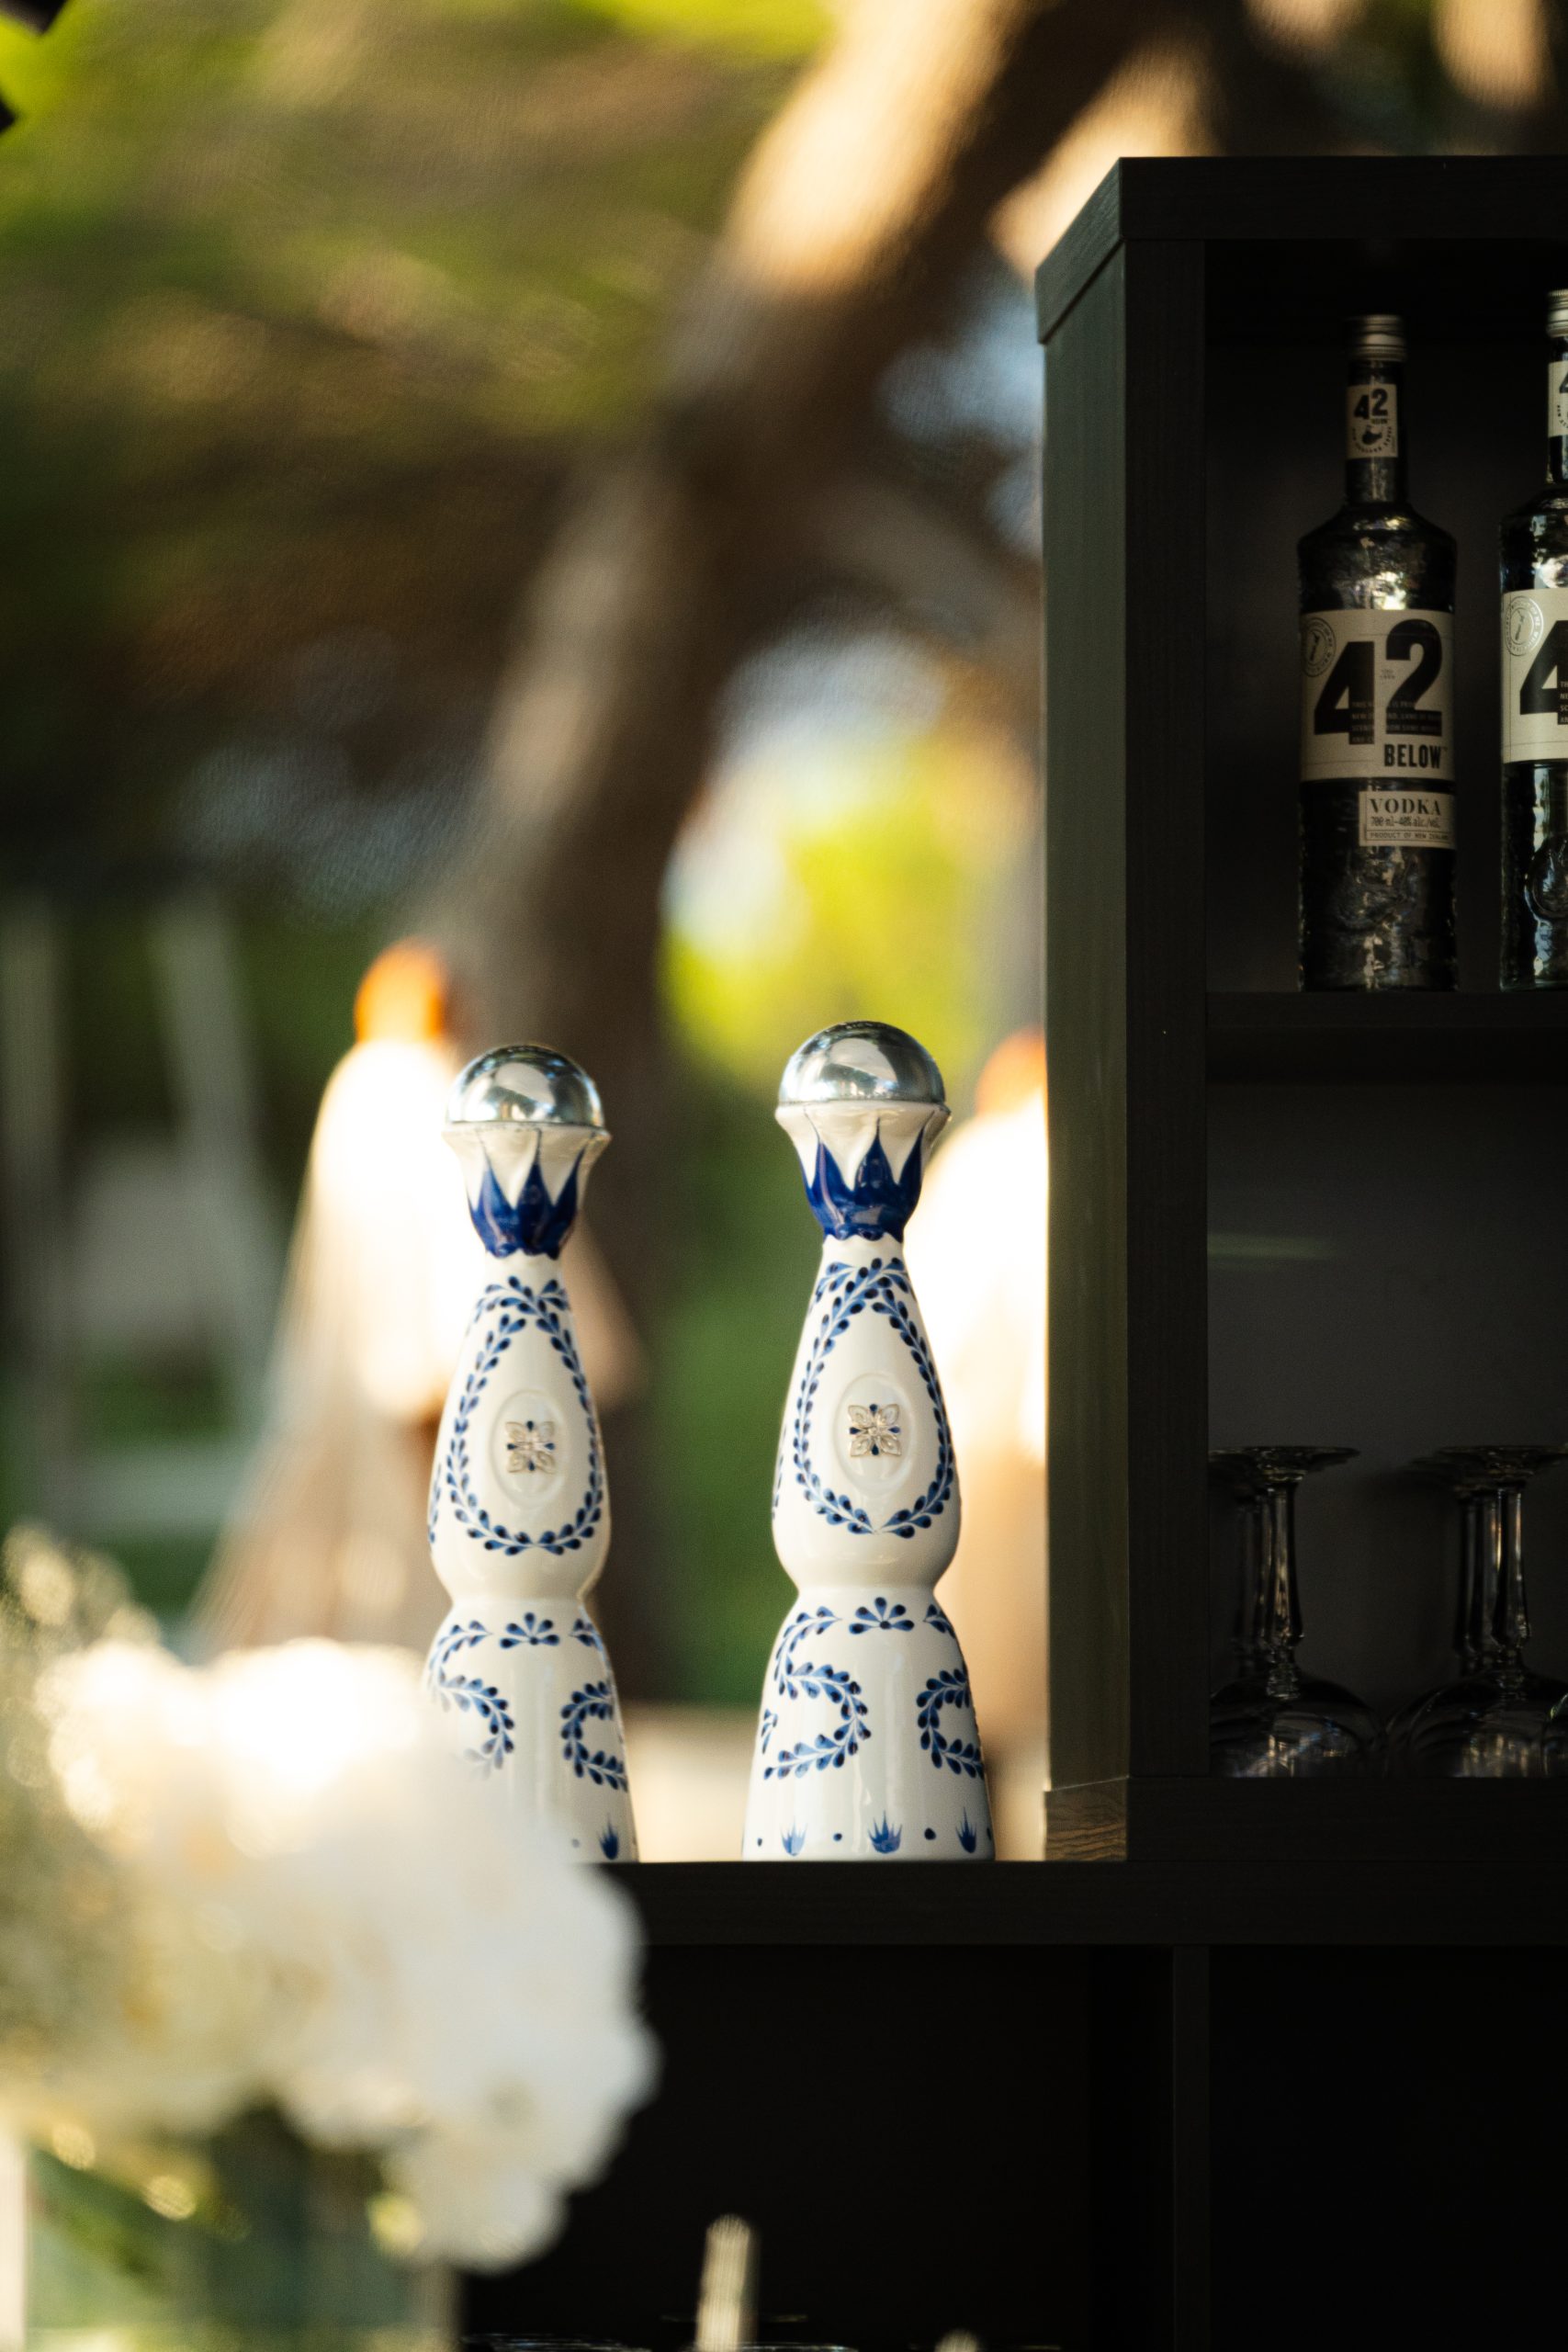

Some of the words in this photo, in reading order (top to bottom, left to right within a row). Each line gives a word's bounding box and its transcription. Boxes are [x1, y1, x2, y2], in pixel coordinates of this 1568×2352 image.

[1354, 389, 1388, 420] 42
[1314, 618, 1442, 744] 42
[1384, 744, 1441, 768] BELOW
[1370, 798, 1441, 815] VODKA
